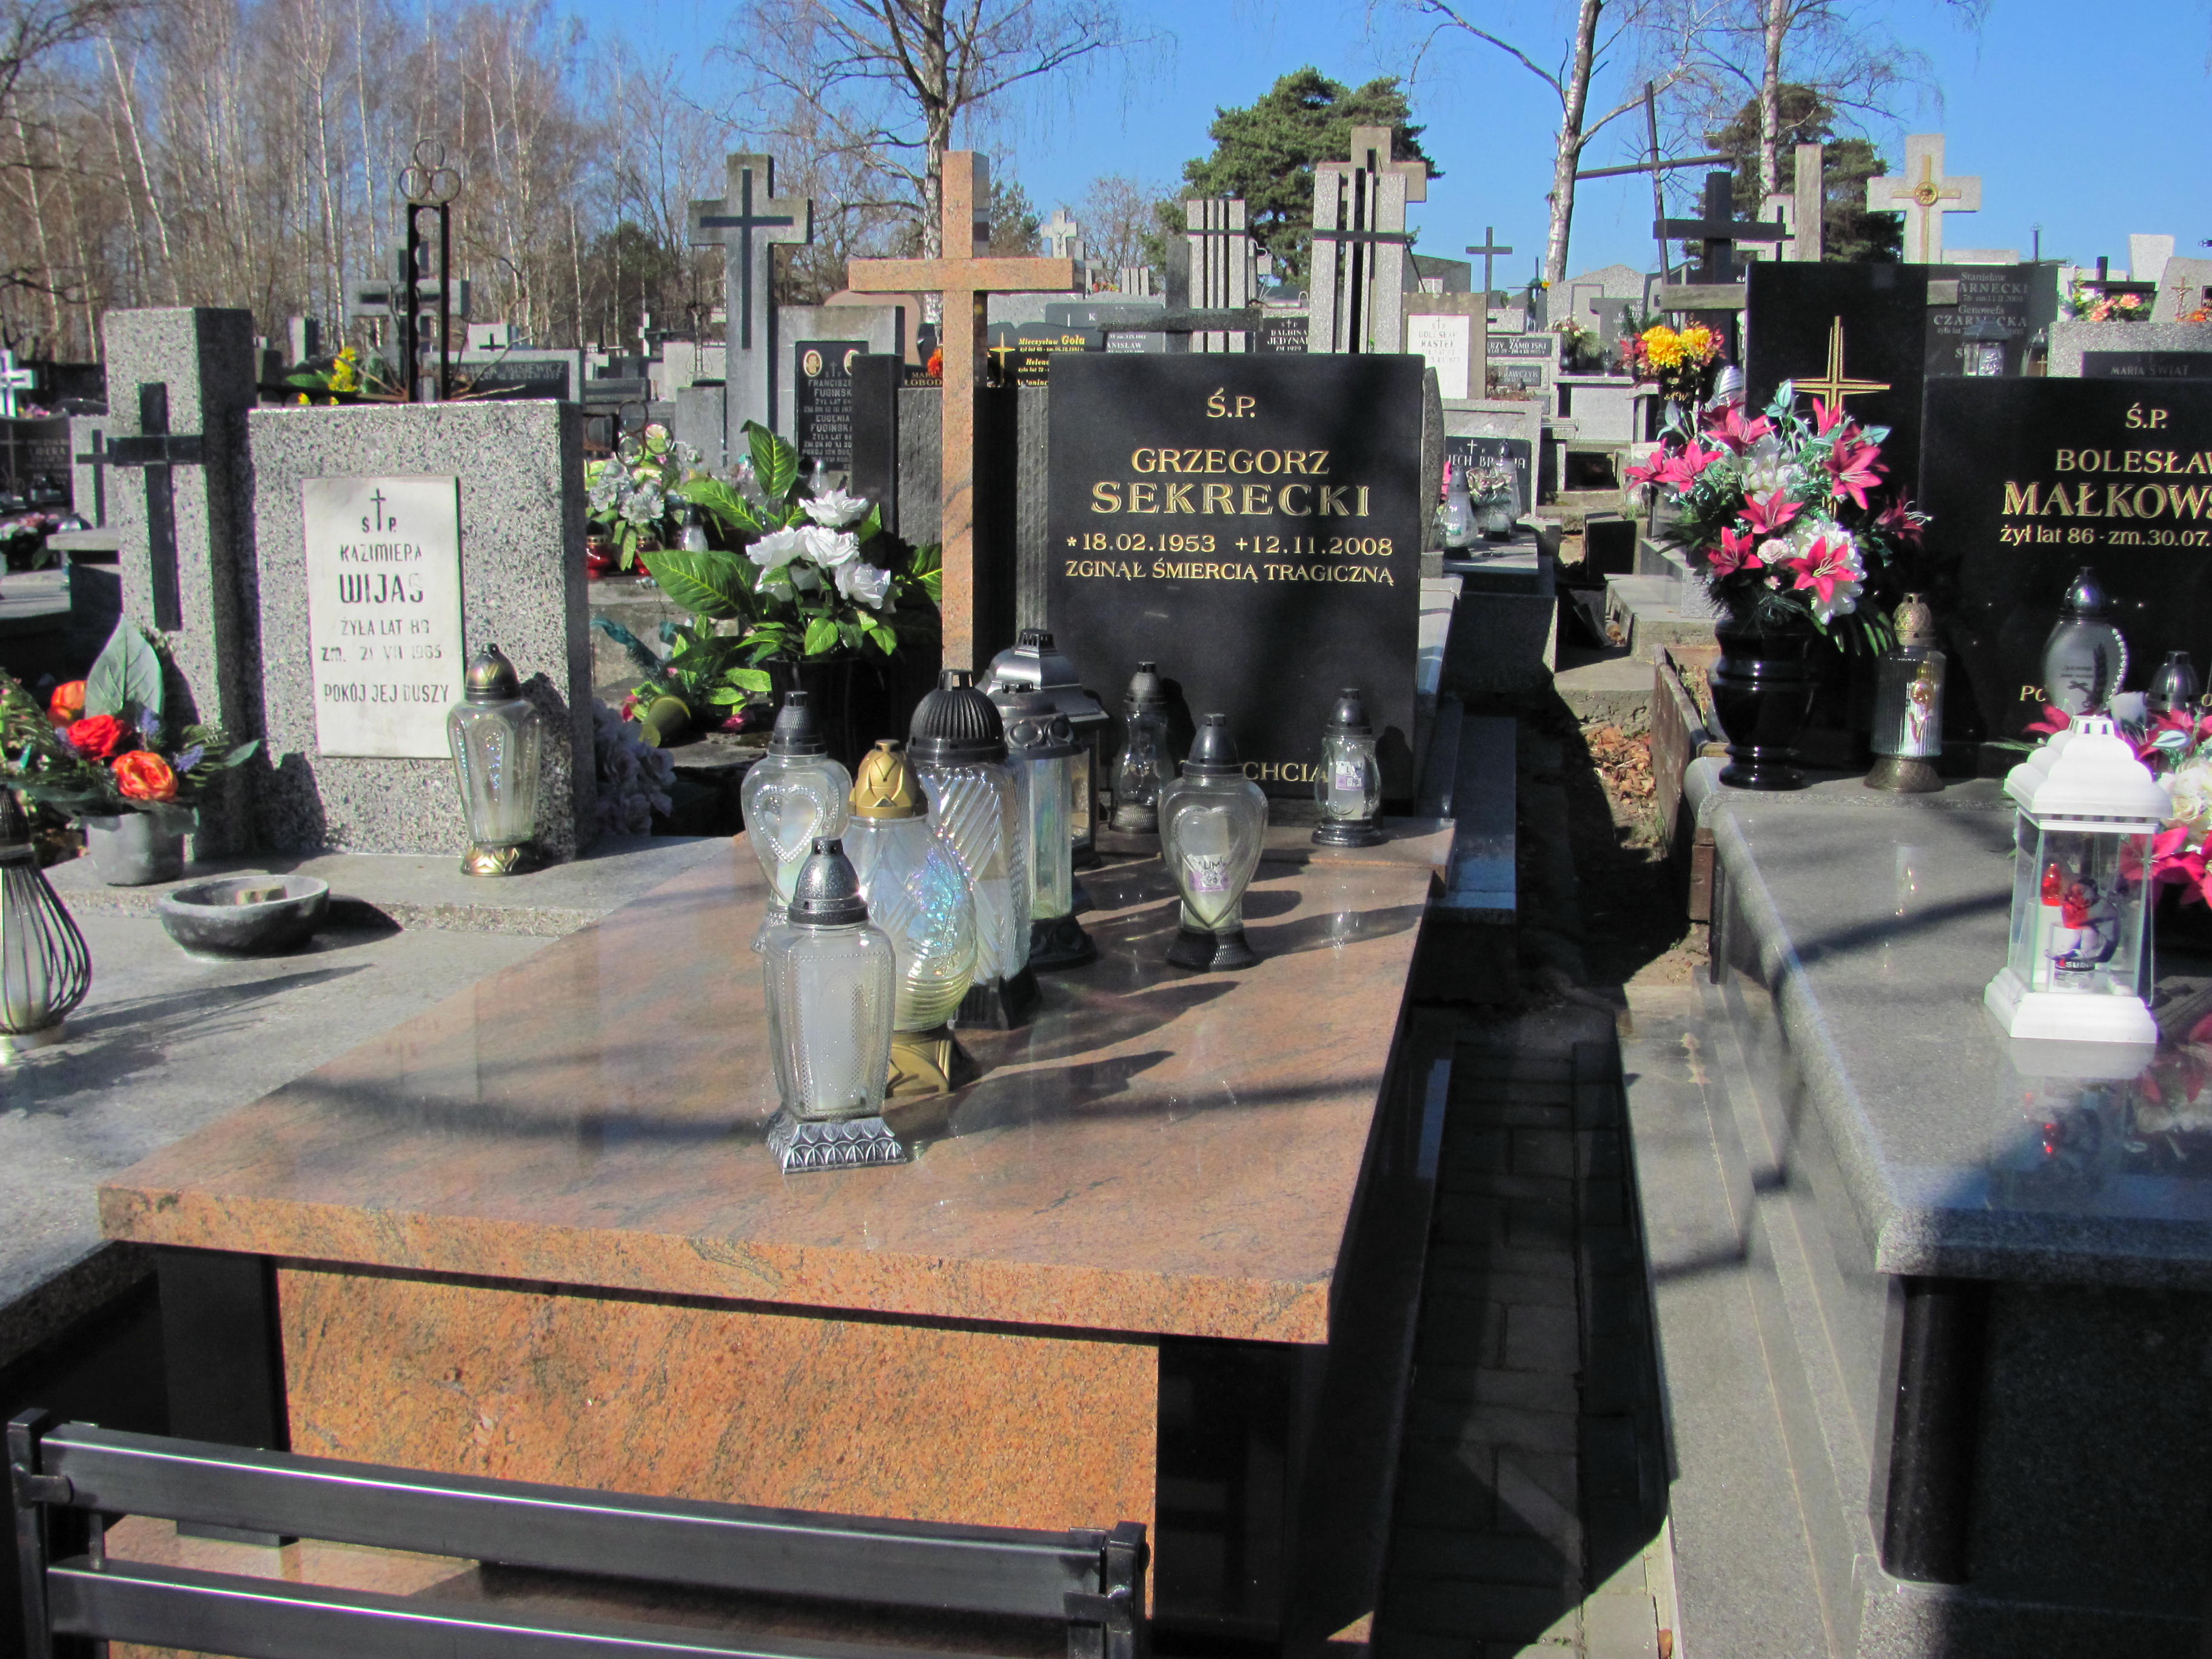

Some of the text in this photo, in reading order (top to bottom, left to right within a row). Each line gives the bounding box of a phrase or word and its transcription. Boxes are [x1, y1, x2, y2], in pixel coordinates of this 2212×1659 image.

[1960, 283, 2028, 293] ARNECKI
[1207, 387, 1256, 418] Ś.P.
[2125, 402, 2169, 429] Ś.P.
[1131, 447, 1330, 474] GRZEGORZ
[2054, 448, 2212, 474] BOLESŁA
[1091, 481, 1370, 517] SEKRECKI
[2001, 481, 2212, 519] MAŁKOW
[1999, 525, 2032, 546] żył
[2036, 525, 2062, 543] lat
[2067, 528, 2096, 544] 86
[340, 543, 423, 562] KAZIMIERA
[1065, 557, 1395, 586] ZGINĄŁ ŚMIERCIĄ TRAGICZNĄ
[339, 573, 424, 603] WIJAS
[380, 619, 403, 635] LAT
[324, 682, 449, 703] POKÓJ JEJ DUSZY
